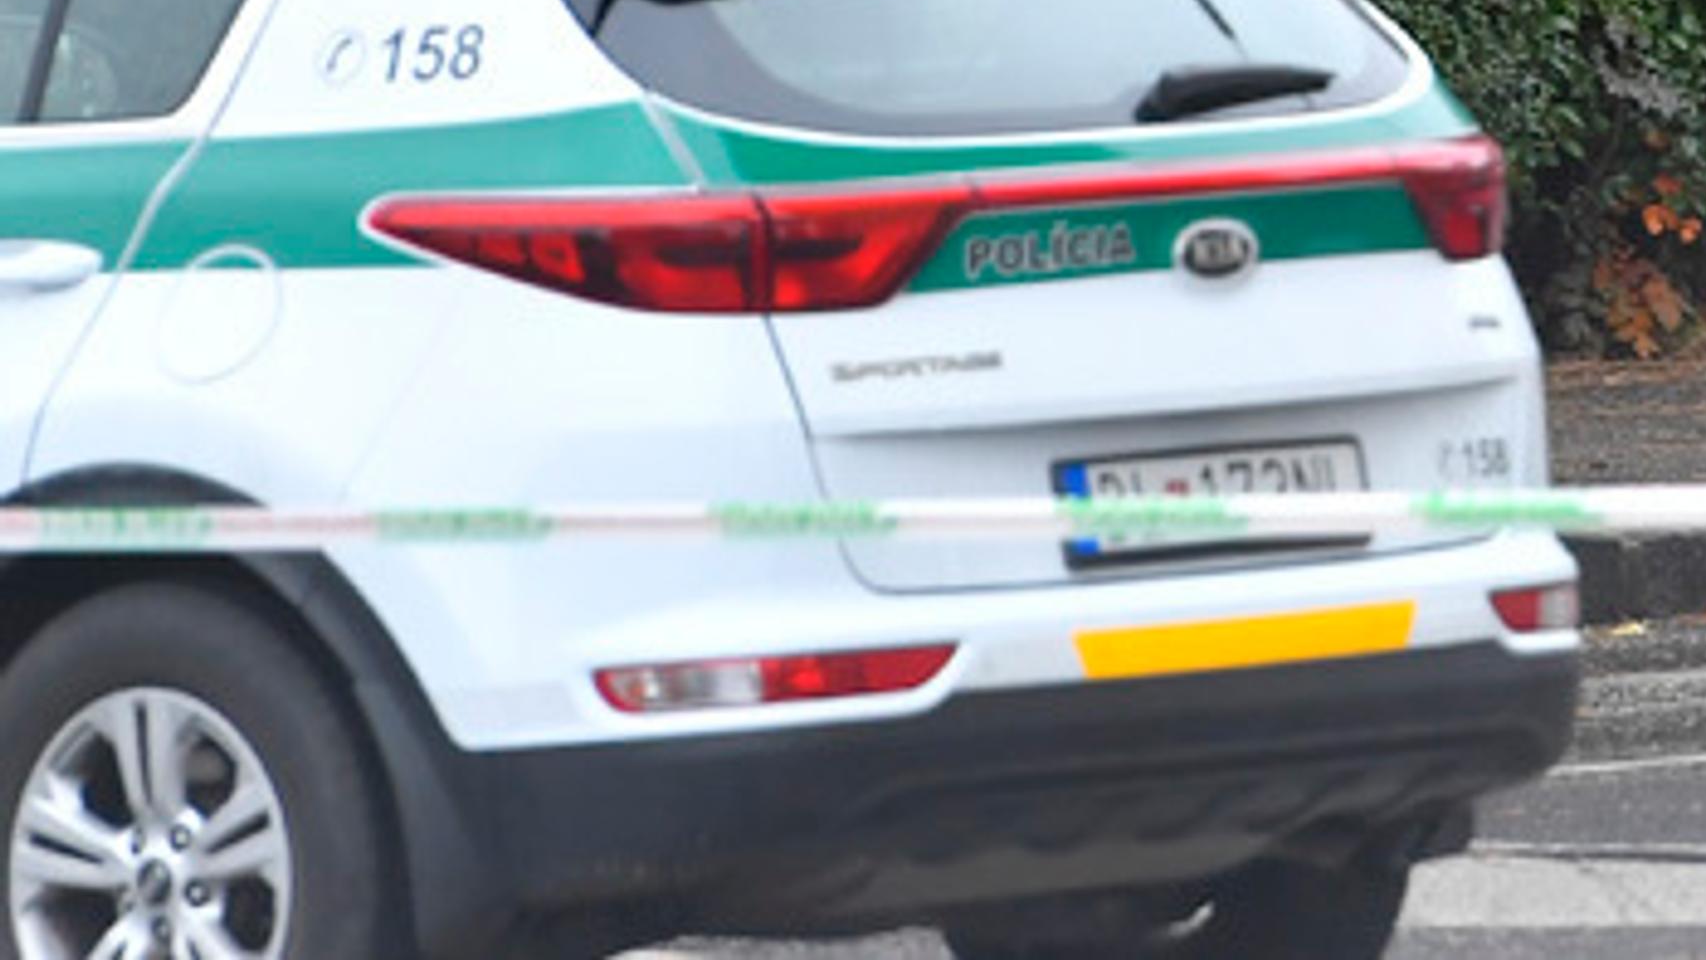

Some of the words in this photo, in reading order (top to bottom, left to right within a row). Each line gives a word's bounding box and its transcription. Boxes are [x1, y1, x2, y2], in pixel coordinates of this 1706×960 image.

[383, 24, 484, 82] 158
[965, 220, 1135, 278] POLÍCIA
[1461, 437, 1510, 478] 158
